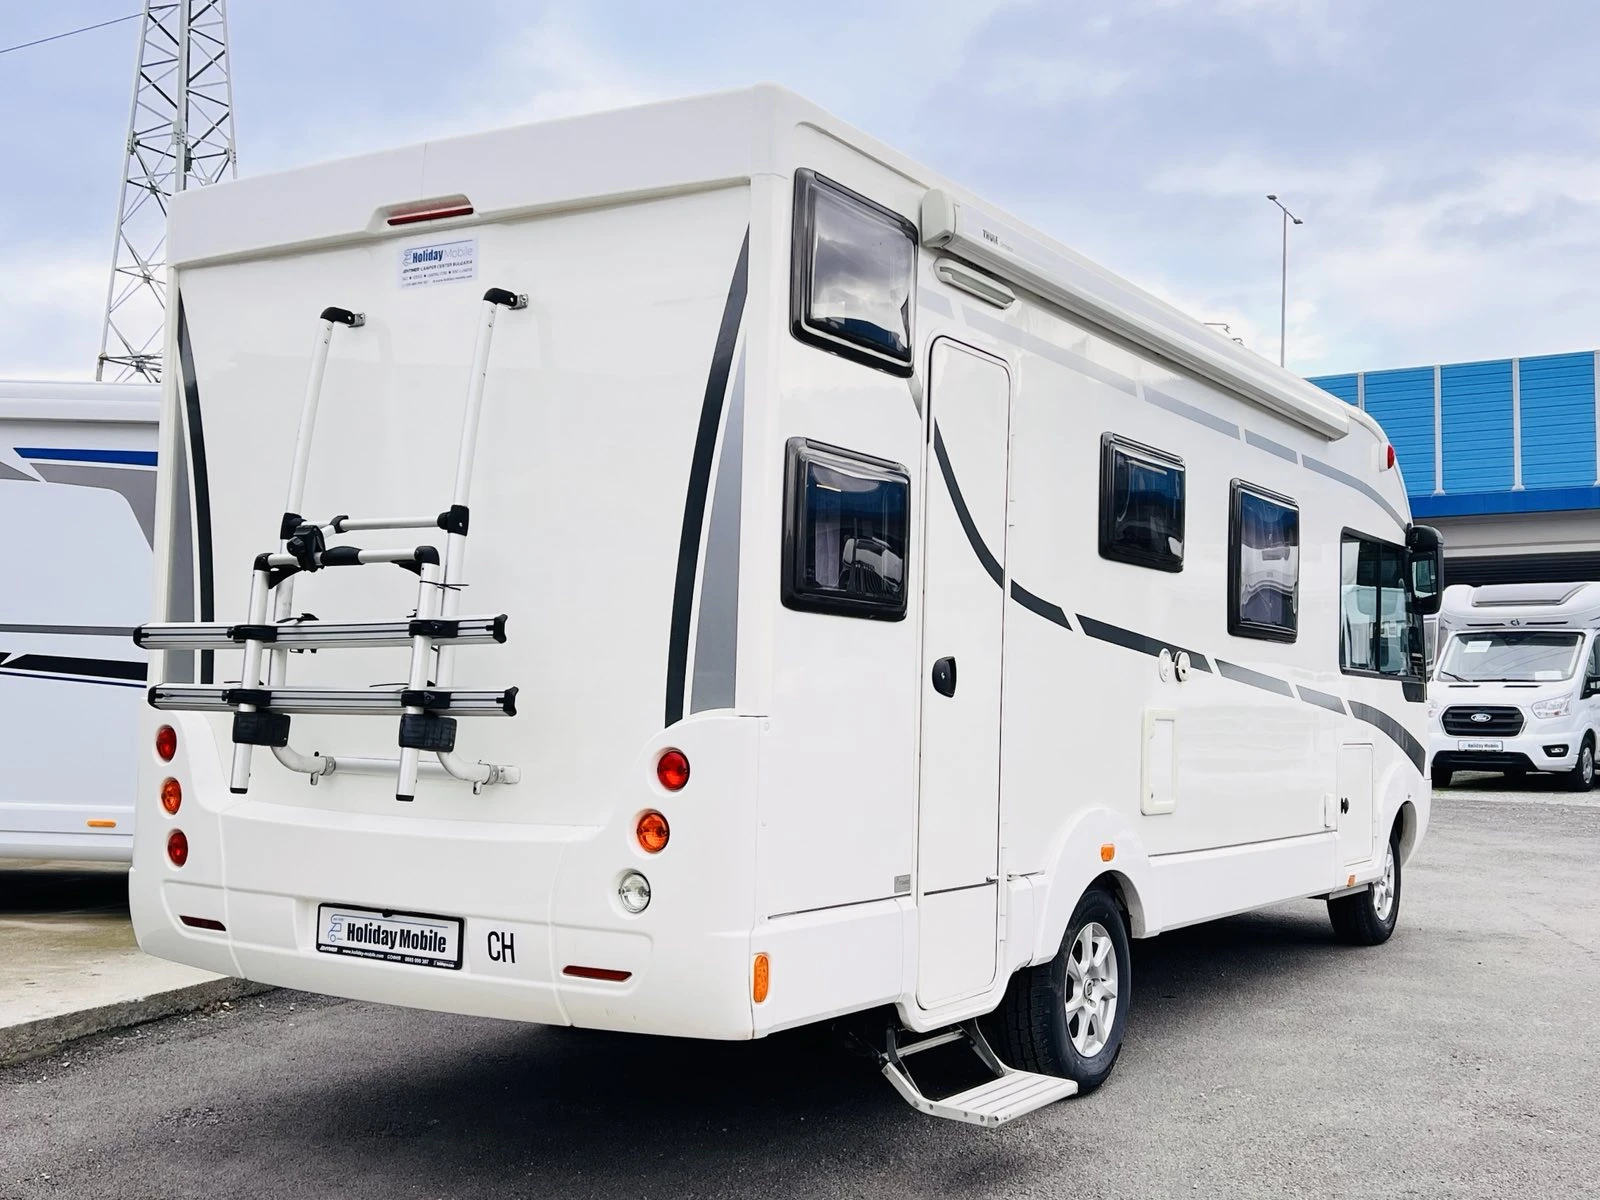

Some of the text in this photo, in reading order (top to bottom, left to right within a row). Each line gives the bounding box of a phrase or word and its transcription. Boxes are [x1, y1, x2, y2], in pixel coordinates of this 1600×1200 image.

[982, 228, 999, 246] THULE
[413, 246, 473, 263] Holiday Mobile
[346, 921, 447, 953] Holiday Mobile
[487, 930, 516, 964] CH
